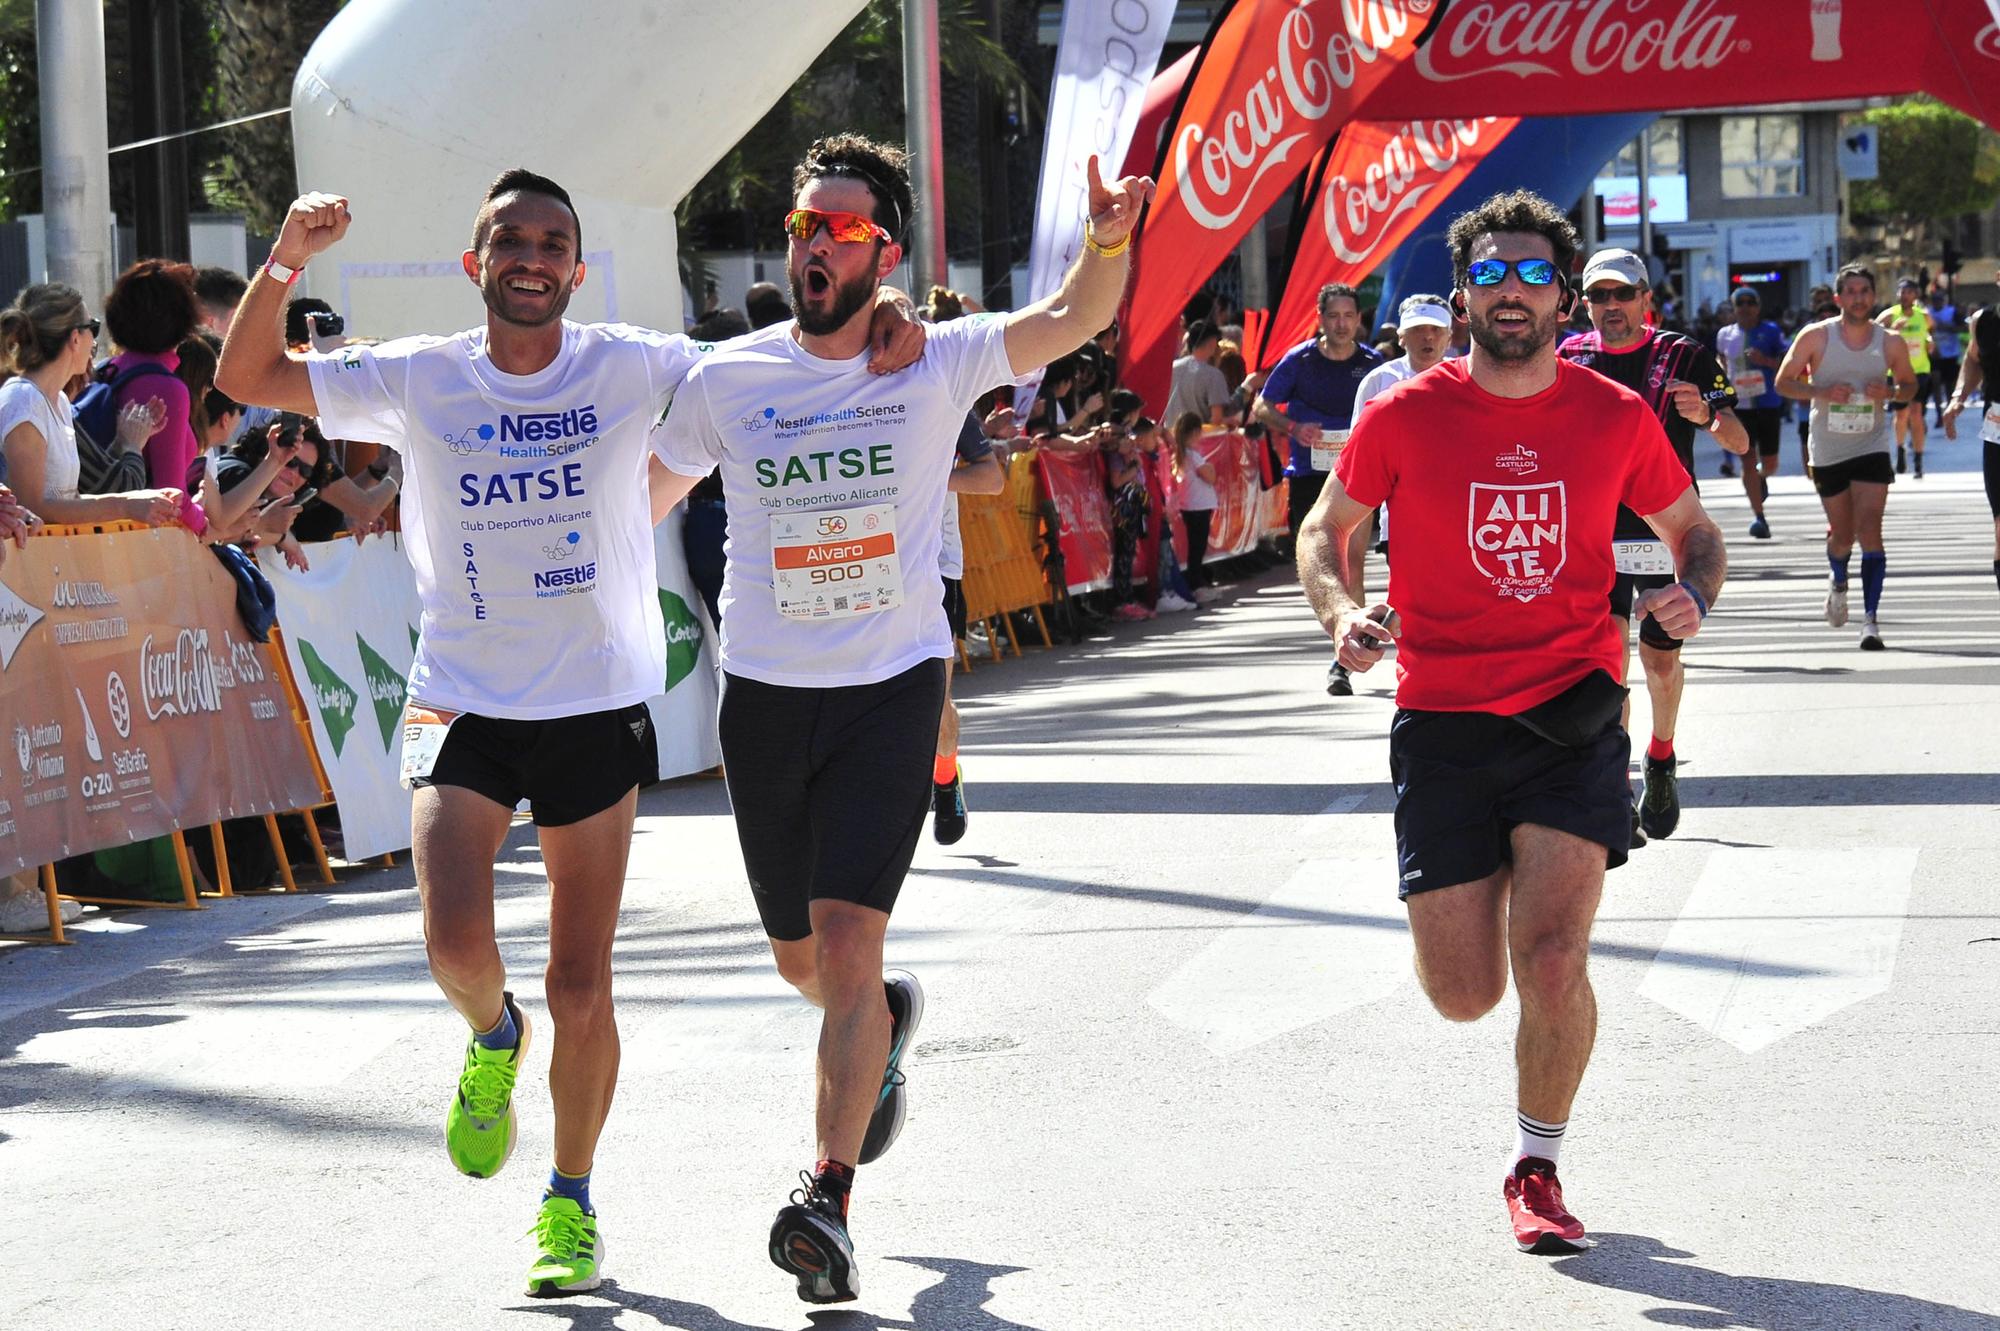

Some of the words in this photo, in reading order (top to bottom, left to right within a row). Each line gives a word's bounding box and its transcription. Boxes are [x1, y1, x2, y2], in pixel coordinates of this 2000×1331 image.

[1414, 0, 1738, 83] Coca-Cola
[774, 431, 799, 440] Where
[800, 425, 836, 437] Nutrition
[837, 421, 873, 432] becomes
[875, 416, 907, 428] Therapy
[500, 436, 599, 458] HealthScience
[755, 443, 895, 489] SATSE
[459, 463, 586, 507] SATSE
[759, 496, 782, 509] Club
[785, 491, 847, 508] Deportivo
[850, 485, 899, 501] Alicante
[1486, 493, 1549, 521] ALI
[460, 520, 484, 532] Club
[487, 516, 544, 531] Deportivo
[547, 509, 592, 525] Alicante
[1475, 523, 1560, 552] CAN
[1620, 544, 1653, 554] 3170
[806, 544, 864, 562] Alvaro
[1496, 550, 1545, 578] TE
[810, 564, 864, 585] 900
[1491, 577, 1503, 586] LA
[1503, 577, 1543, 587] CONQUISTA
[1498, 587, 1513, 597] LOS
[1514, 586, 1553, 597] CASTILLOS
[31, 720, 62, 749] Antonio
